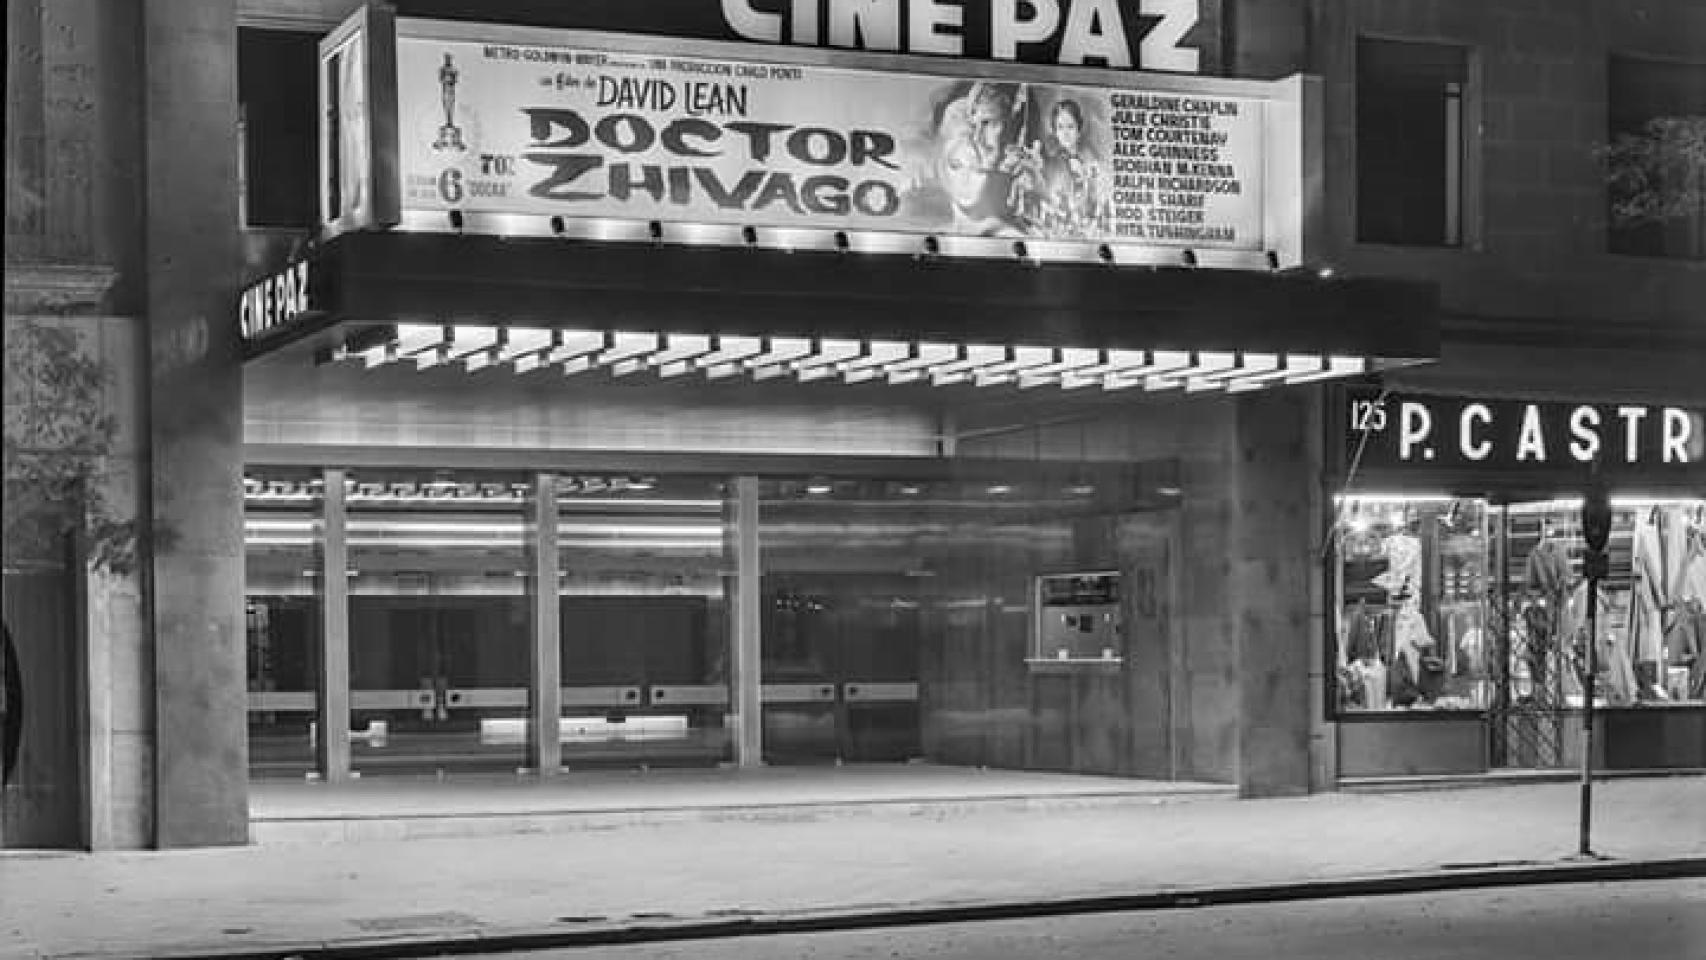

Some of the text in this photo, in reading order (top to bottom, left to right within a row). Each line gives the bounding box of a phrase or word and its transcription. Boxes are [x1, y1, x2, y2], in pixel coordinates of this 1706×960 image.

[720, 0, 1201, 73] CINE PAZ
[597, 75, 676, 111] DAVID
[683, 81, 748, 116] LEAN
[1182, 98, 1238, 116] CHAPLIN
[1111, 110, 1212, 129] JULIE CHRISTIE
[1112, 125, 1143, 140] TOM
[519, 108, 902, 170] DOCTOR
[1113, 141, 1219, 161] ALEC GUINNESS
[439, 167, 464, 202] 6
[520, 153, 900, 217] ZHIVAGO
[240, 258, 310, 340] CINE PAZ
[1352, 399, 1387, 431] 125
[1400, 401, 1435, 460] P.
